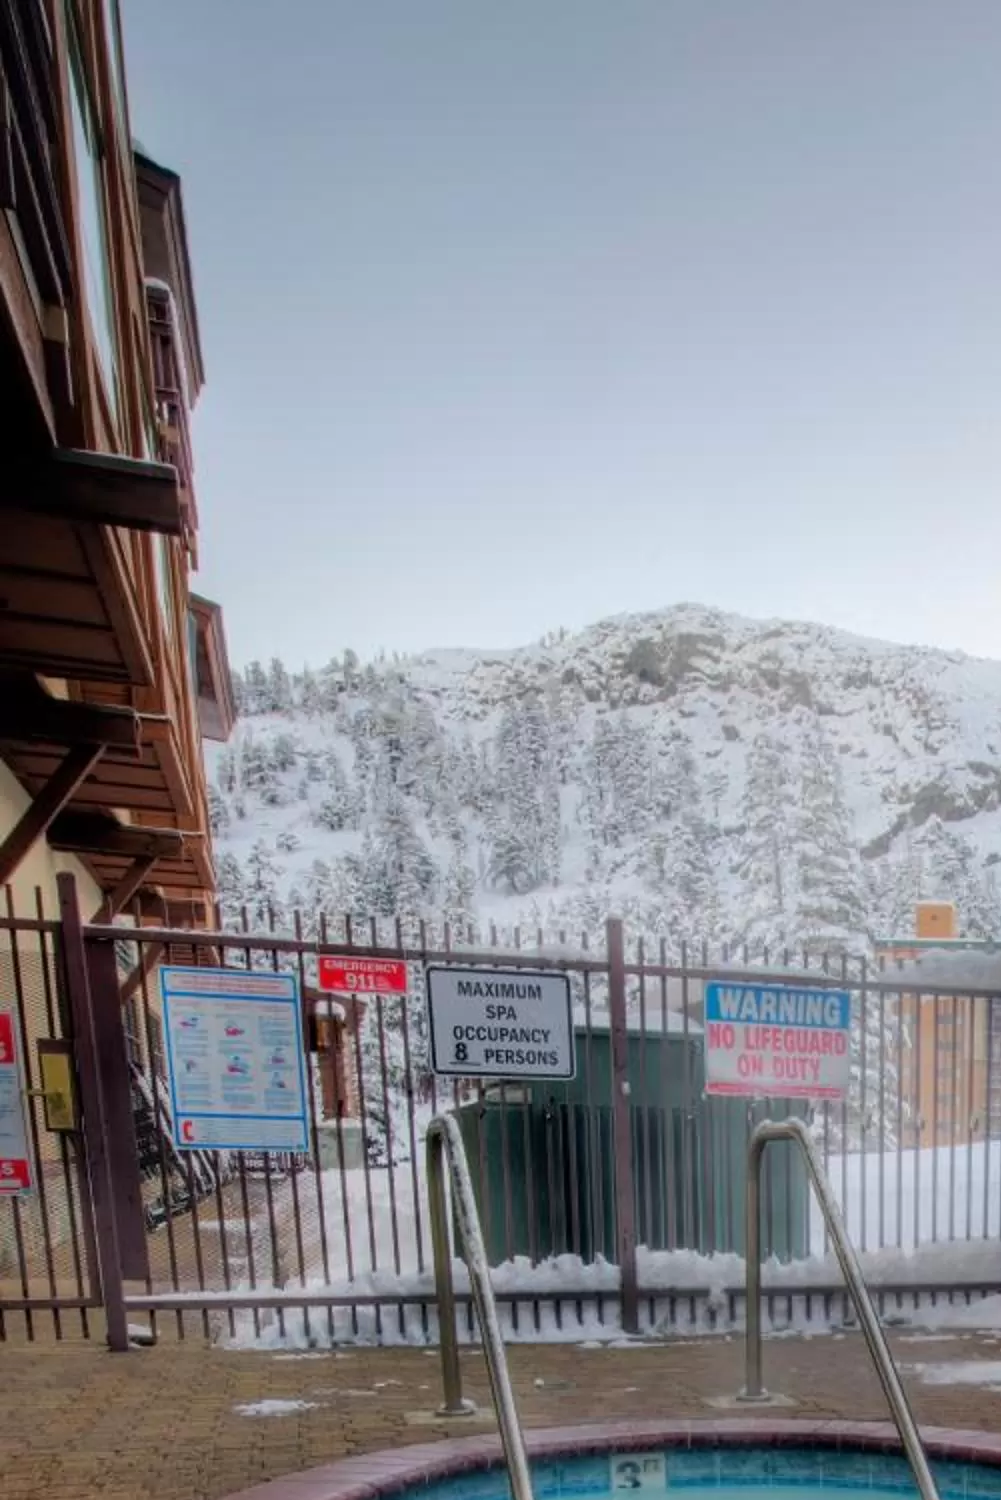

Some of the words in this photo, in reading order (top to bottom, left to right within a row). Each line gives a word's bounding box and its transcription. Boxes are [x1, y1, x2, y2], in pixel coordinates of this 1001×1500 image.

[344, 971, 377, 989] 911
[457, 980, 542, 1000] MAXIMUM
[485, 1004, 517, 1021] SPA
[716, 987, 841, 1026] WARNING
[452, 1025, 551, 1044] OCCUPANCY
[708, 1023, 735, 1050] NO
[744, 1025, 847, 1056] LIFEGUARD
[454, 1042, 469, 1061] 8
[483, 1049, 559, 1066] PERSONS
[737, 1053, 763, 1077] ON
[772, 1056, 820, 1081] DUTY
[615, 1460, 642, 1489] 3
